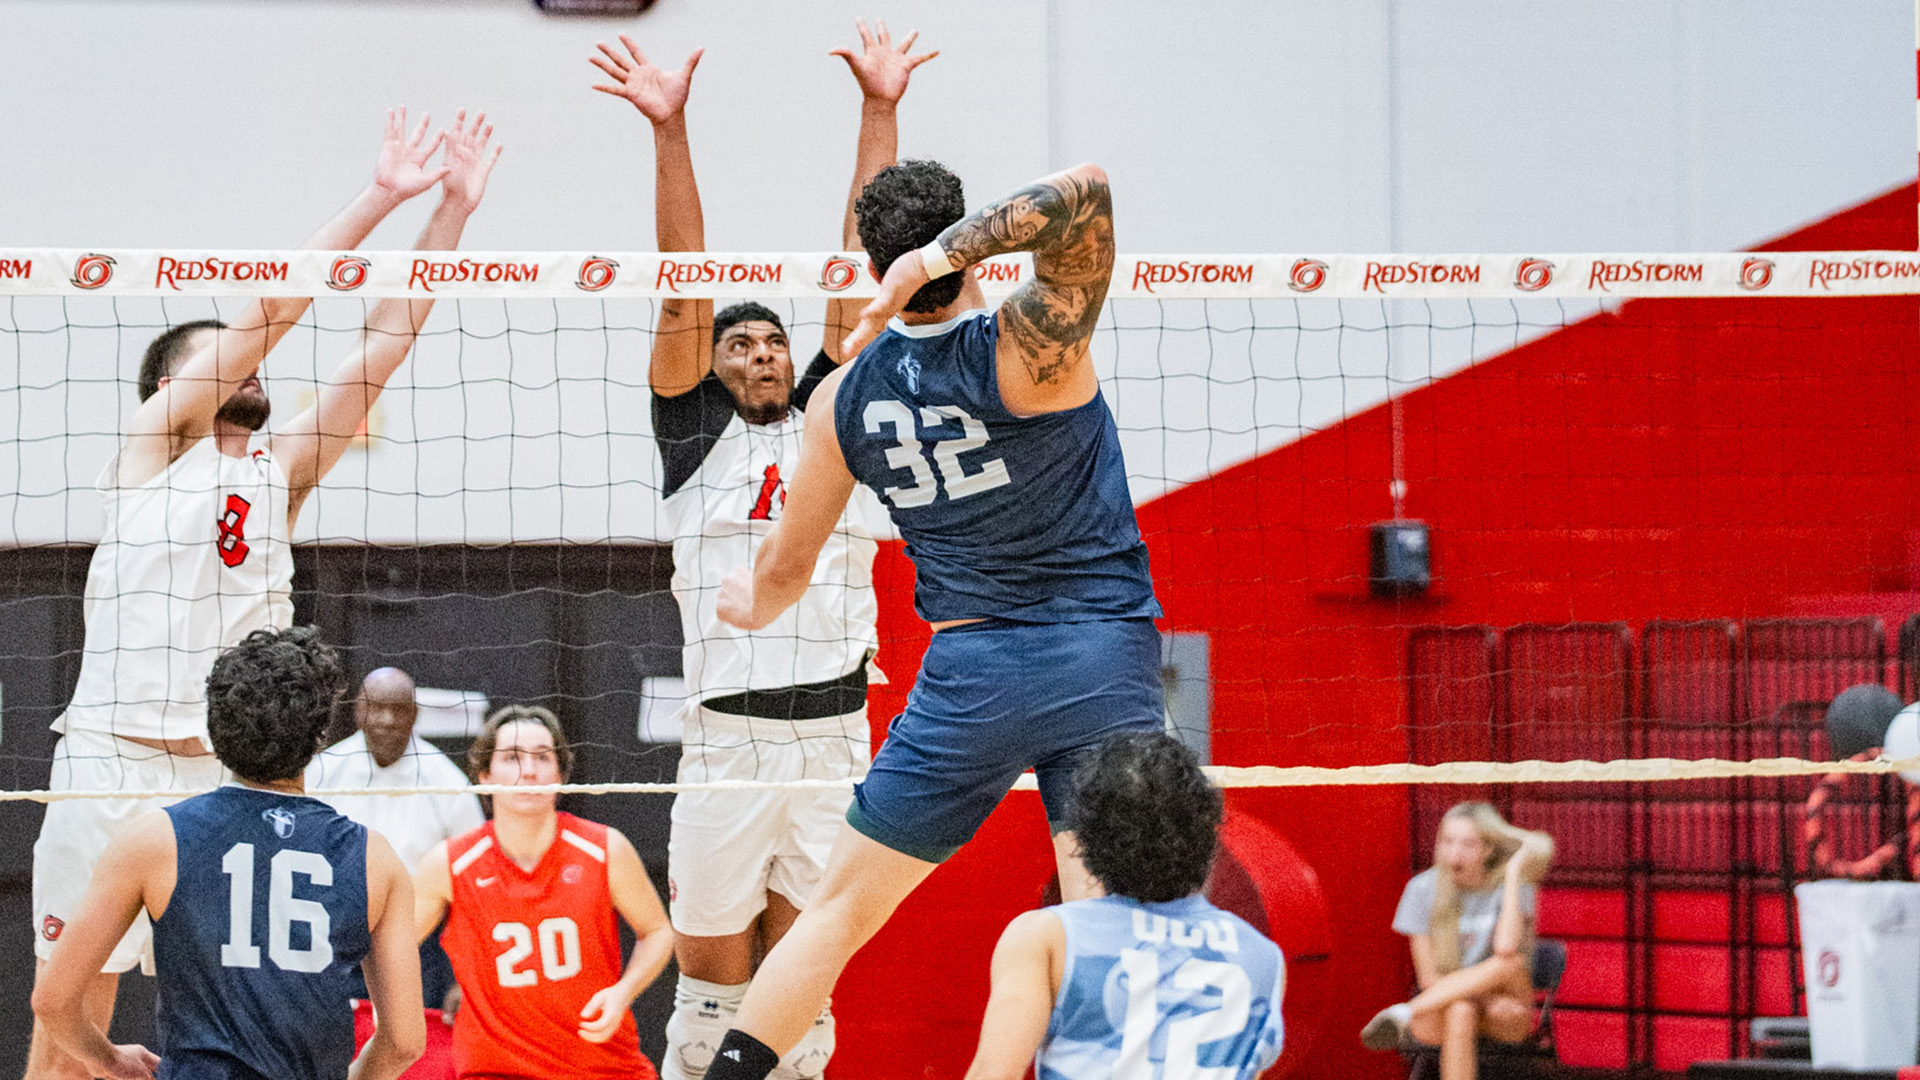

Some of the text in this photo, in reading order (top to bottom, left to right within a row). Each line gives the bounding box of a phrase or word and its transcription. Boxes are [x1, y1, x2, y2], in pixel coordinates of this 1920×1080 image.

[748, 462, 787, 521] 1
[863, 400, 1012, 509] 32
[216, 493, 251, 568] 8
[221, 842, 334, 974] 16
[492, 916, 583, 988] 20
[1111, 947, 1252, 1080] 12
